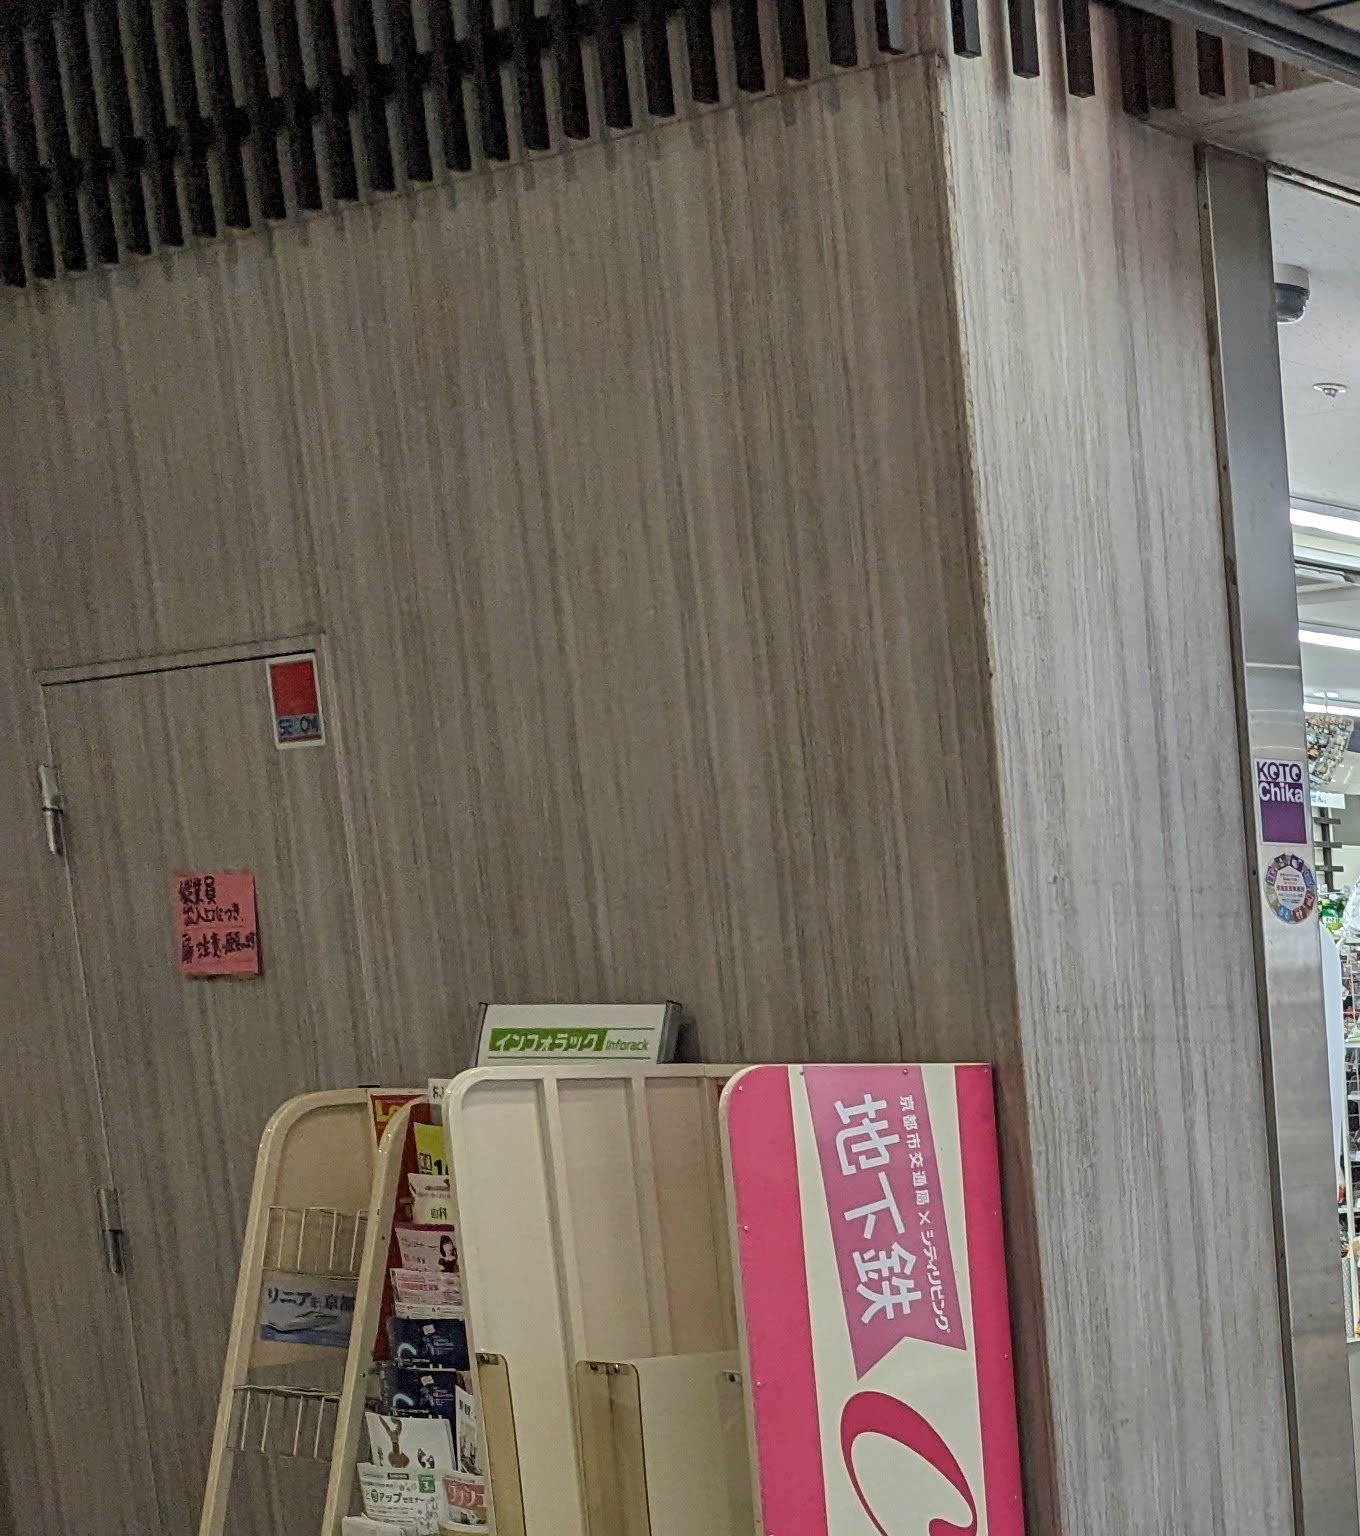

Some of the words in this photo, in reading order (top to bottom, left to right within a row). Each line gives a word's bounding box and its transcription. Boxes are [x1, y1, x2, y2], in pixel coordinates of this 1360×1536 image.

[1256, 761, 1302, 782] KOTO
[1258, 782, 1304, 803] Chika
[495, 1031, 600, 1051] インフォラック
[834, 1093, 922, 1324] 地下鉄
